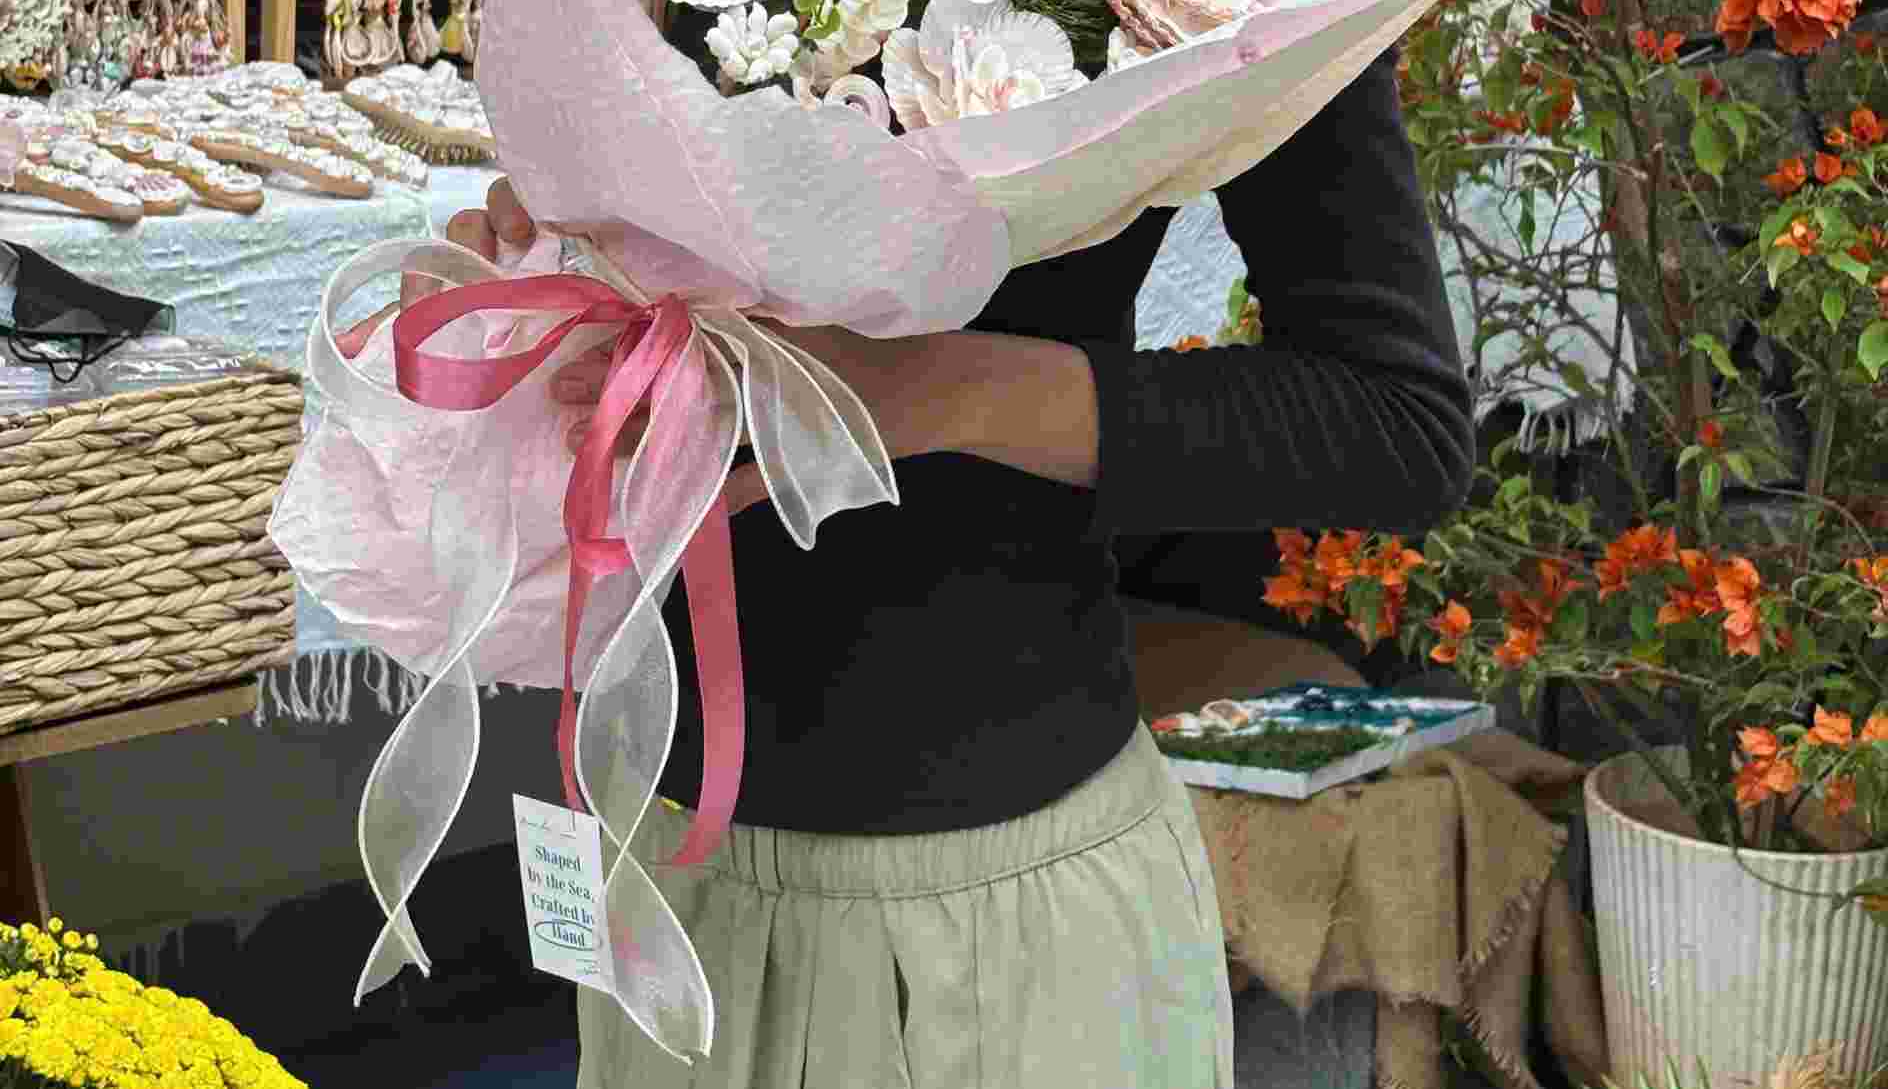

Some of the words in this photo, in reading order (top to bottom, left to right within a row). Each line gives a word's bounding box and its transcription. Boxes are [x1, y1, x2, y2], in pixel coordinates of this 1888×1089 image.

[535, 845, 582, 872] Shaped
[528, 864, 543, 886] by
[546, 872, 566, 890] the
[531, 893, 580, 920] Crafted
[551, 920, 585, 947] Hand
